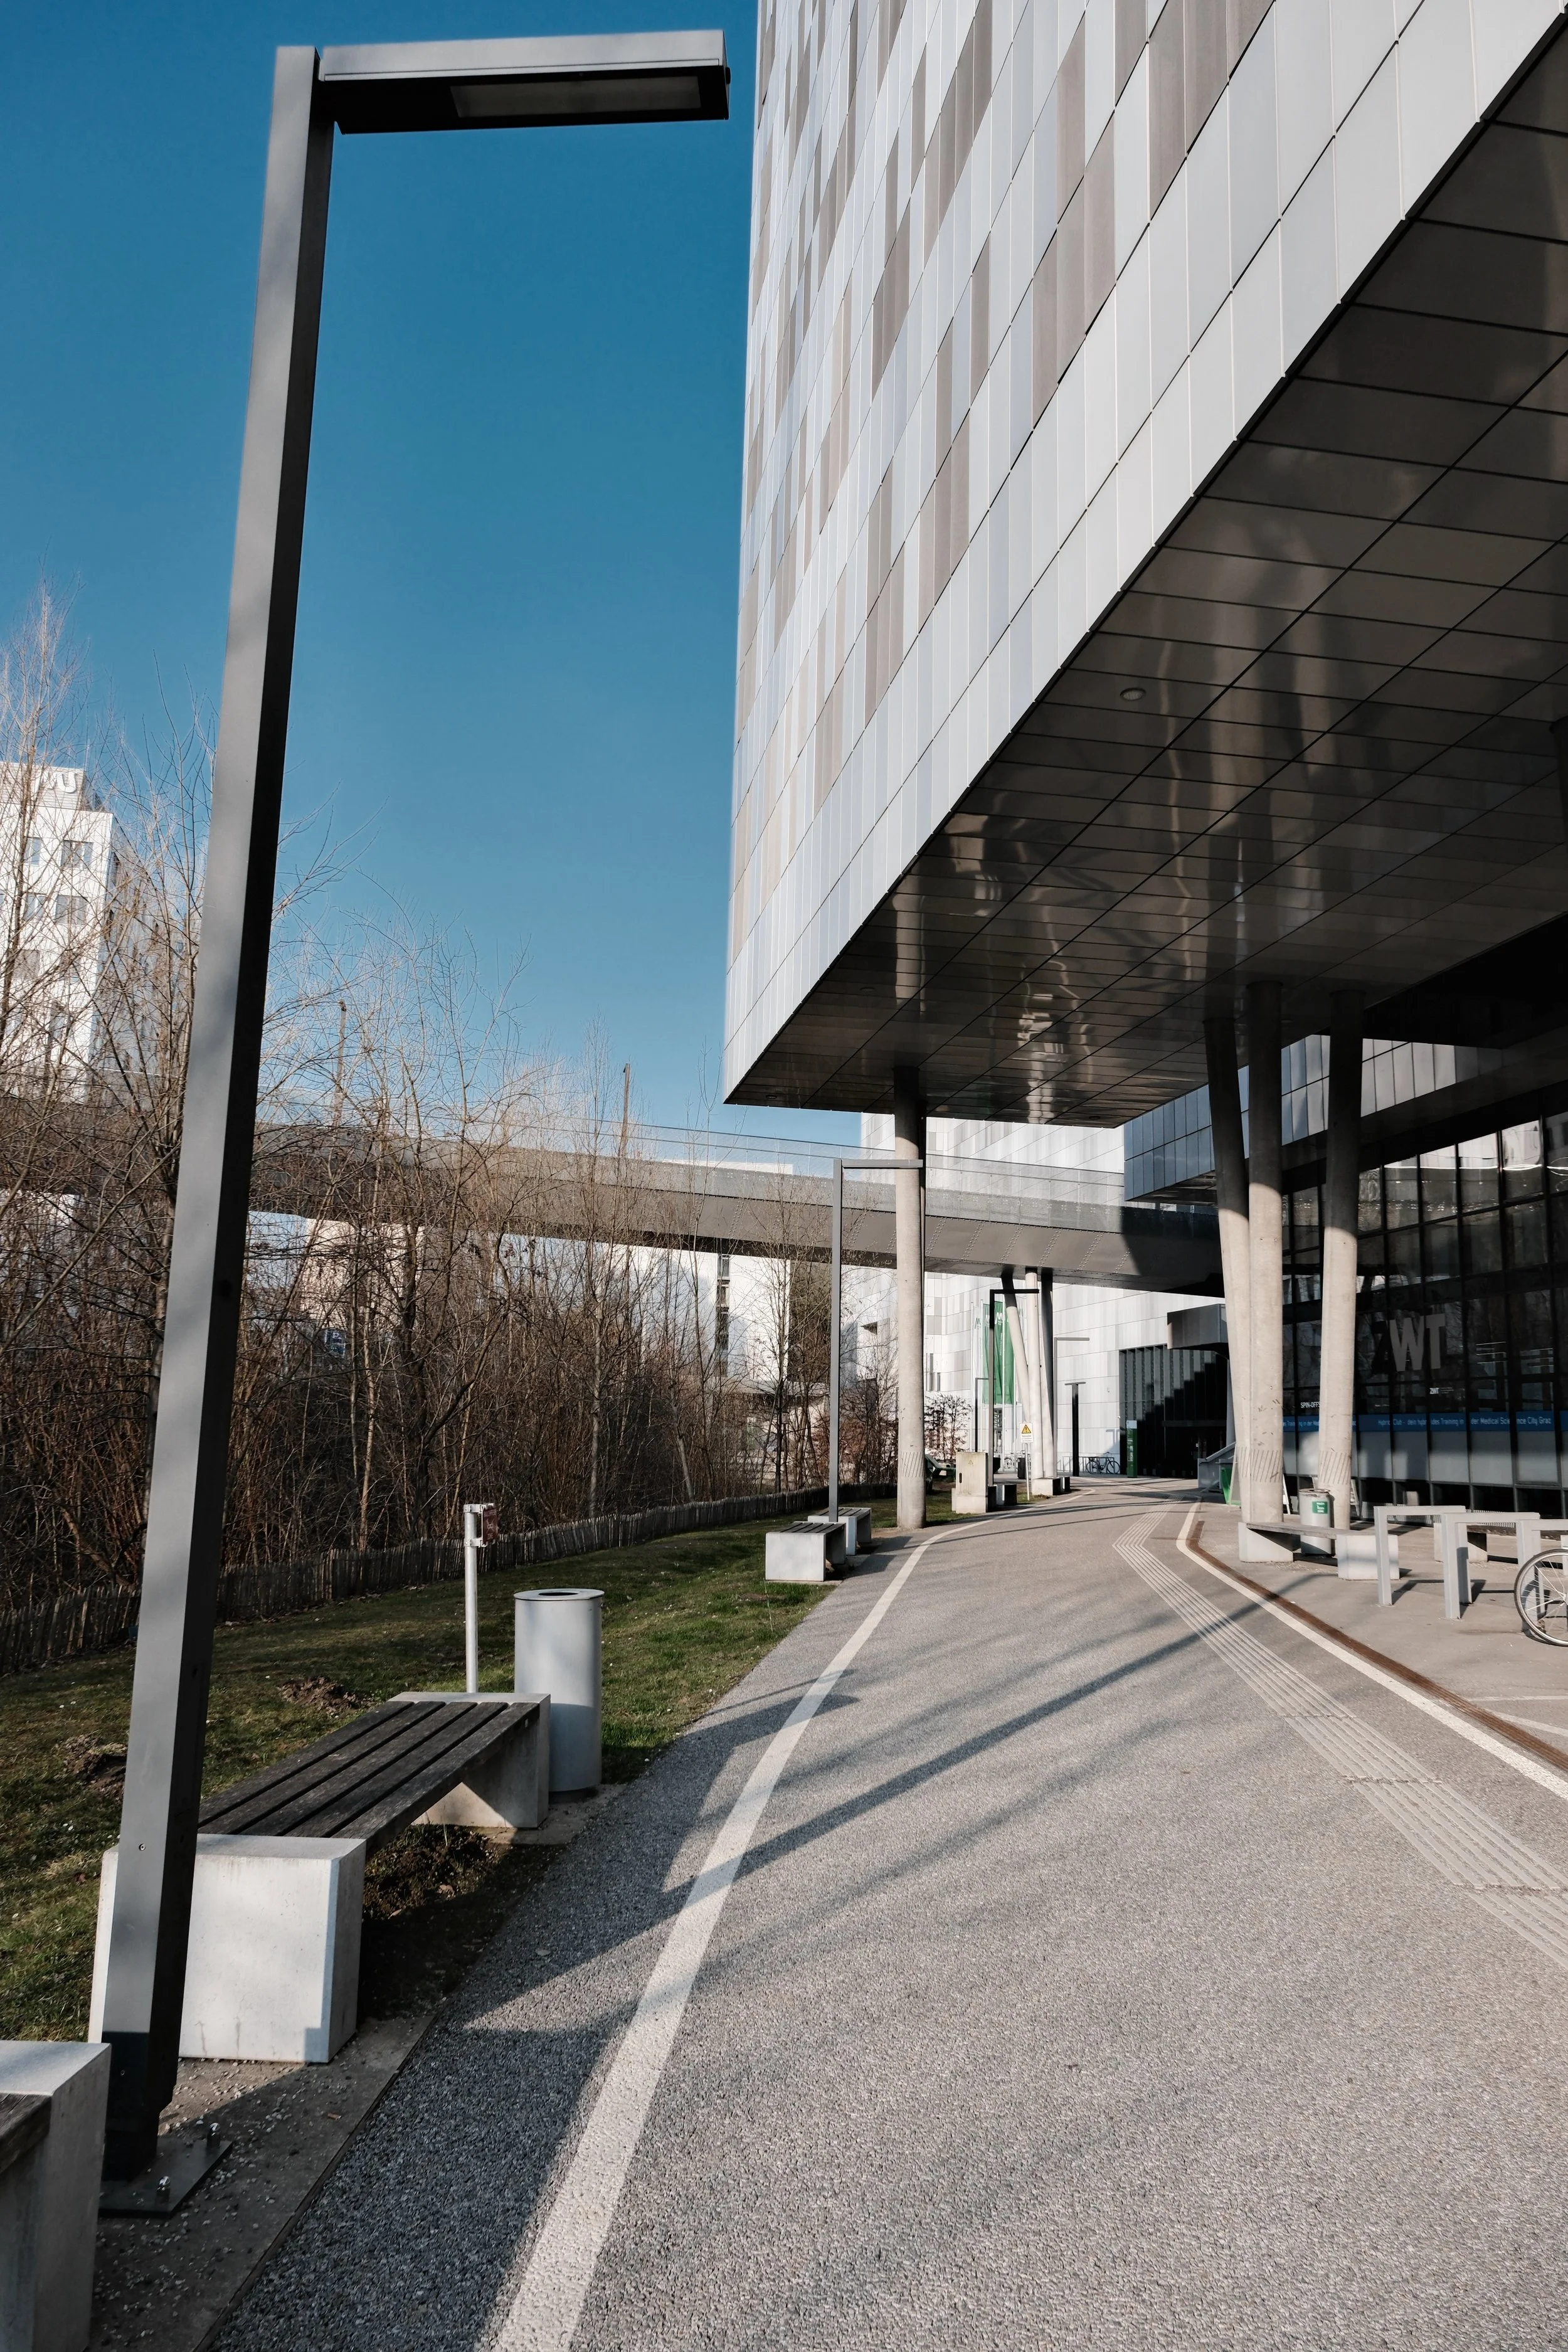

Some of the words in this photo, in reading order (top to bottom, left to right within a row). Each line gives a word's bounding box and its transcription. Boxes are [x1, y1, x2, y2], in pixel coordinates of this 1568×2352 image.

[1441, 1417, 1459, 1427] Training
[1527, 1416, 1539, 1426] City
[1539, 1416, 1552, 1424] Graz
